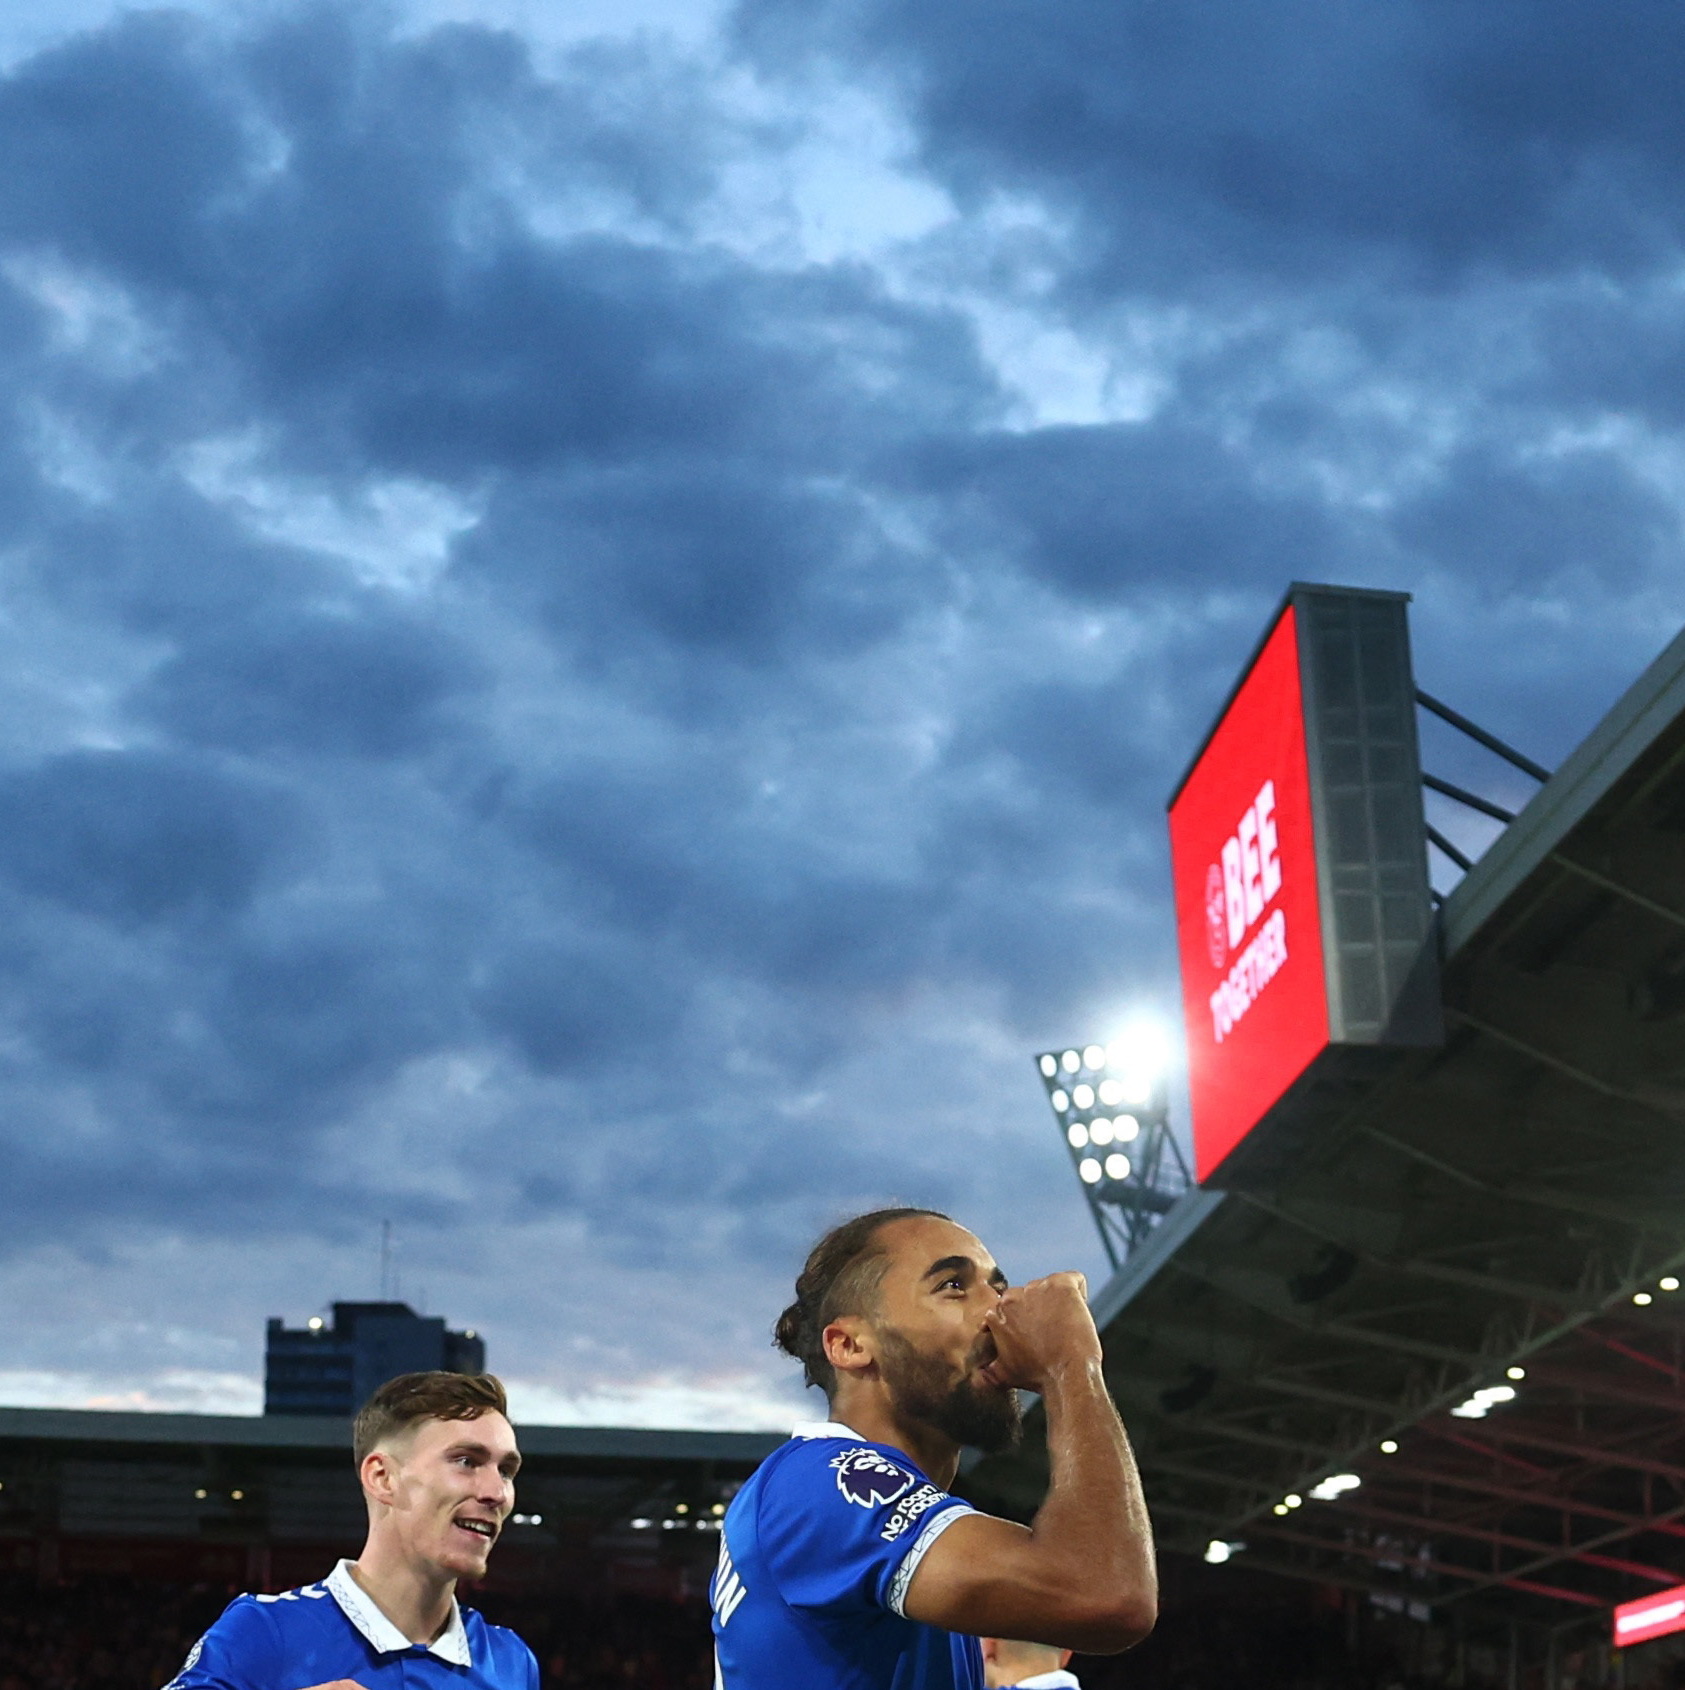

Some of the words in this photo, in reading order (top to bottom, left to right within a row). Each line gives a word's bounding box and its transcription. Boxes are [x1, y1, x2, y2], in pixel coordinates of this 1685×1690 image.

[1221, 779, 1283, 950] BEE
[1210, 908, 1288, 1044] TOGETHER
[880, 1514, 904, 1542] No
[897, 1484, 938, 1515] room
